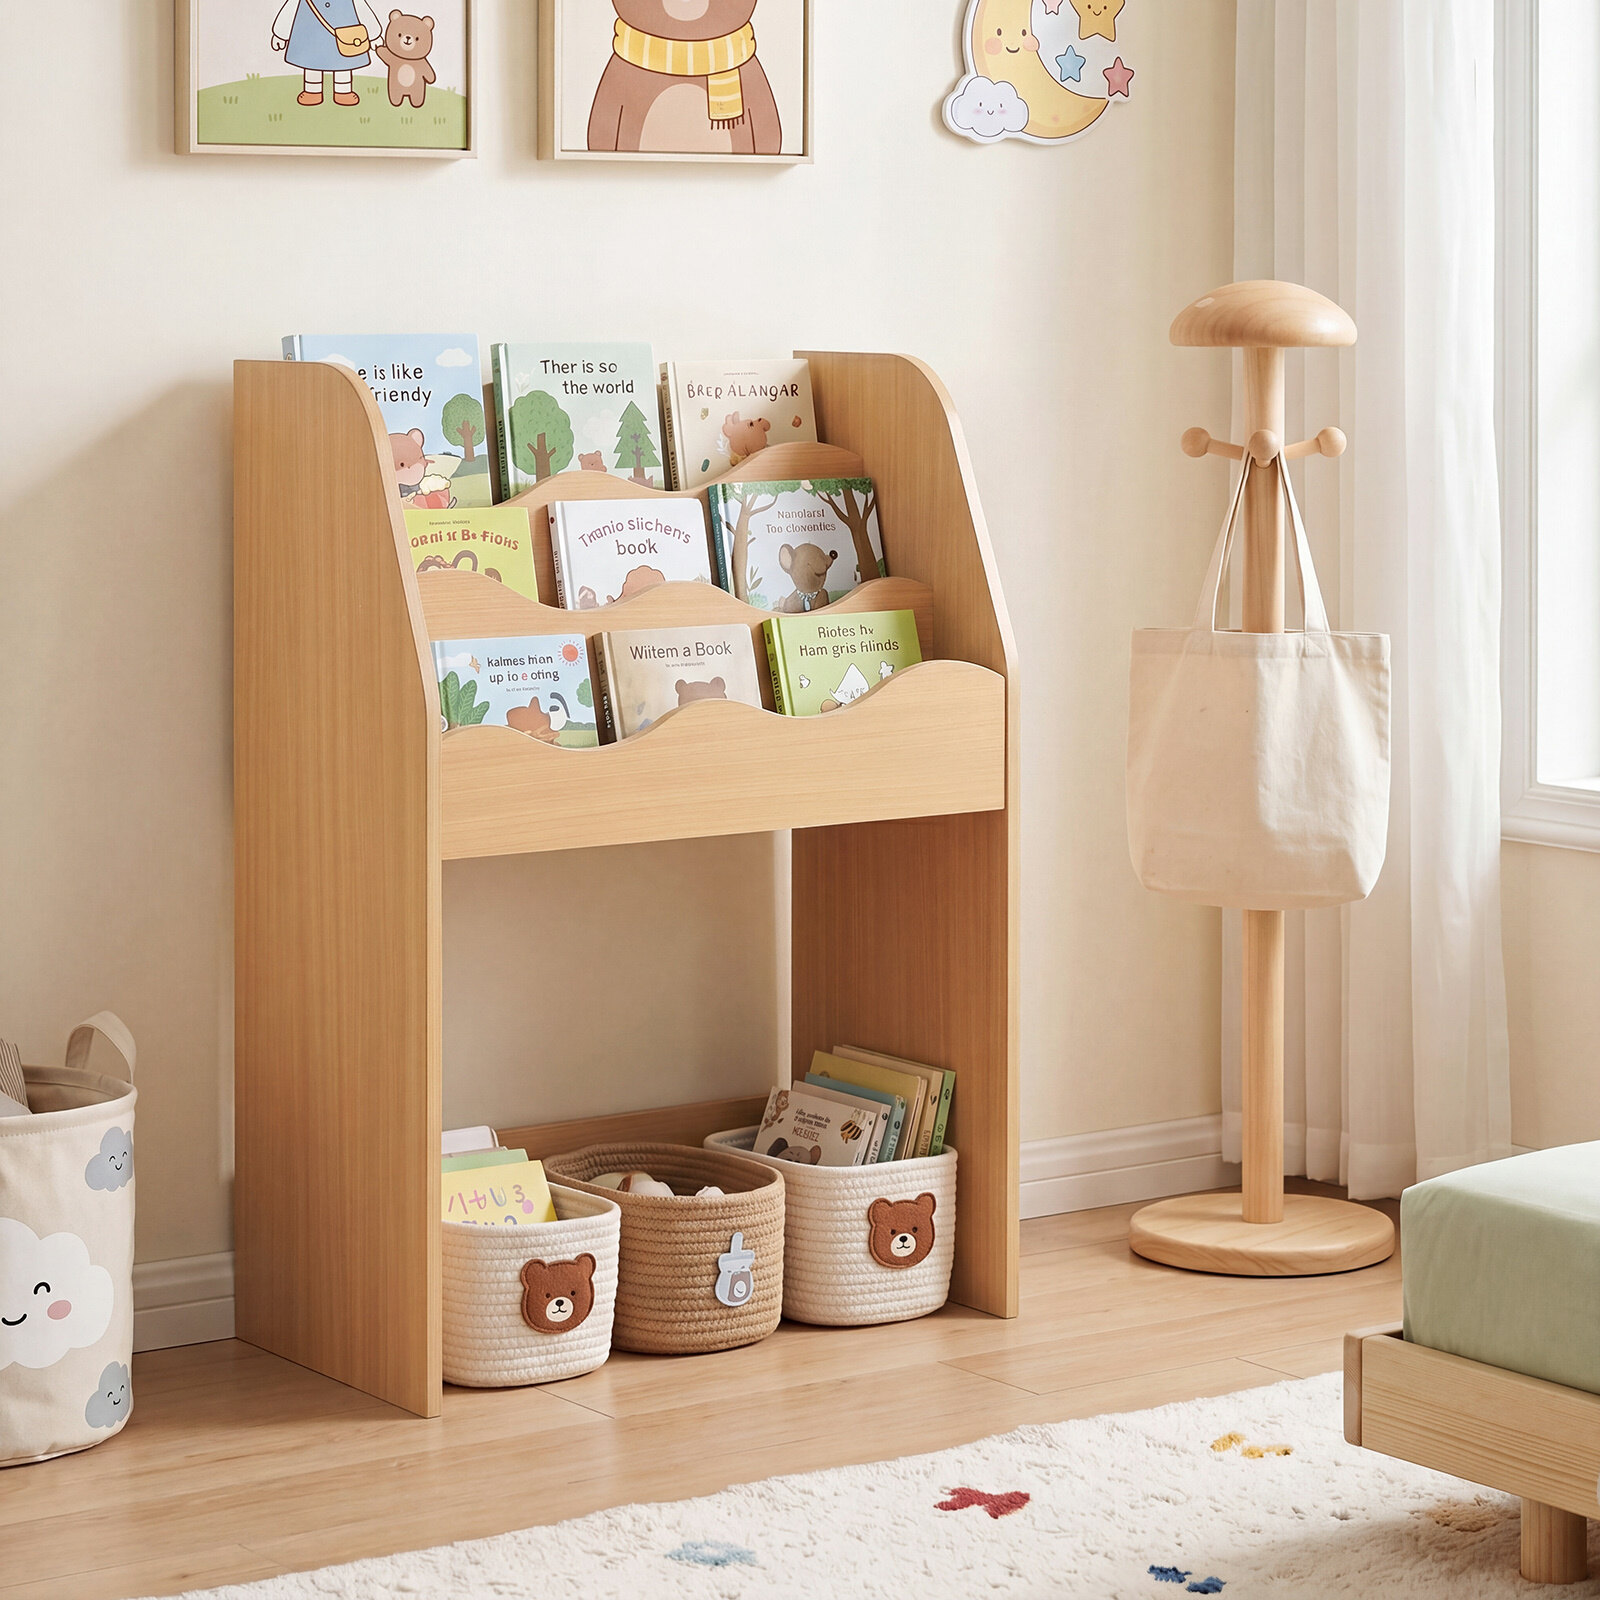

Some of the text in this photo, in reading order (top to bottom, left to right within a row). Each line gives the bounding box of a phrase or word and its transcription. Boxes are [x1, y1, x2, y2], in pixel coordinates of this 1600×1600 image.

[374, 365, 386, 380] is
[391, 363, 423, 380] like
[540, 360, 618, 374] Ther is so
[562, 380, 634, 394] the world
[683, 649, 691, 658] a
[695, 641, 732, 657] Book
[799, 644, 828, 657] Ham
[831, 642, 857, 659] gris
[489, 673, 504, 685] up
[521, 672, 528, 681] e
